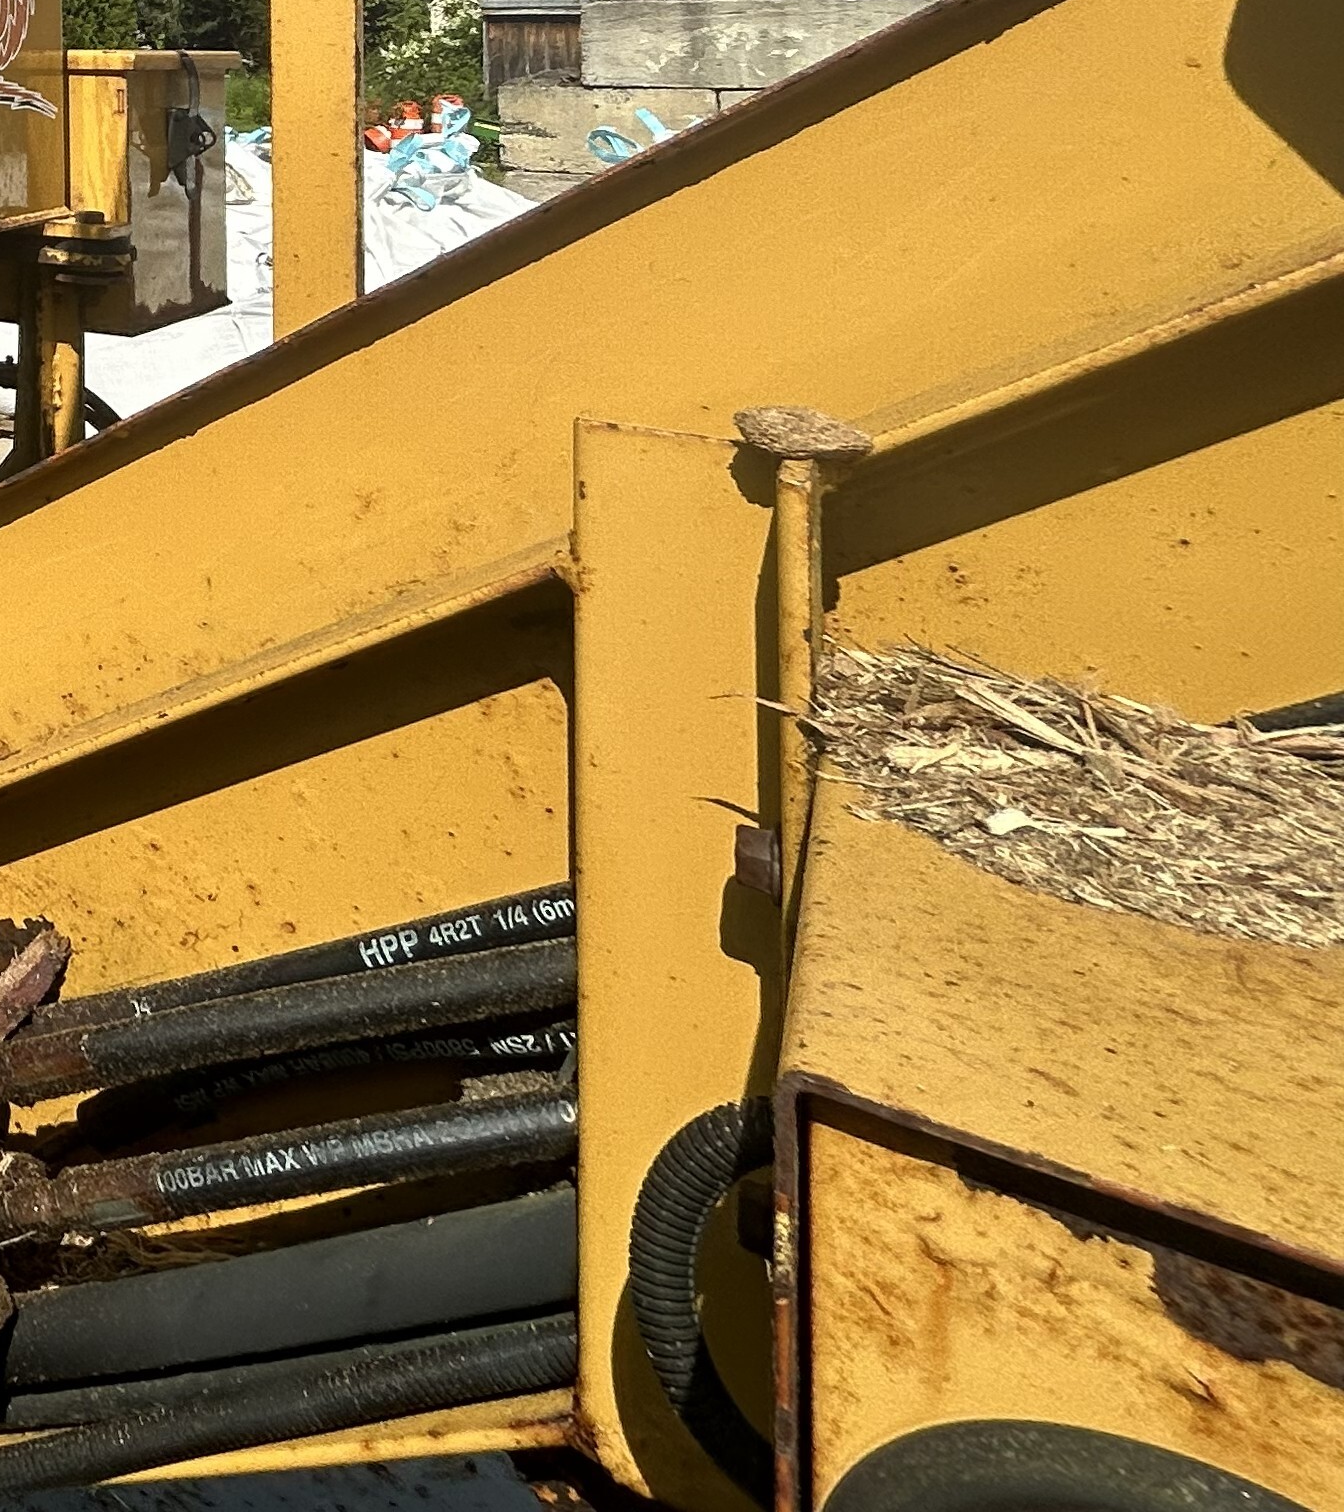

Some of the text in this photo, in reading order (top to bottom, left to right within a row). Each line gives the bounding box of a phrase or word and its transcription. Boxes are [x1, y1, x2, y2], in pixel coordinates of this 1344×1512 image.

[358, 929, 419, 968] HPP
[429, 914, 482, 946] 4R2T
[493, 904, 529, 931] 1/4
[490, 1033, 543, 1056] 2SN
[239, 1146, 302, 1178] MAX
